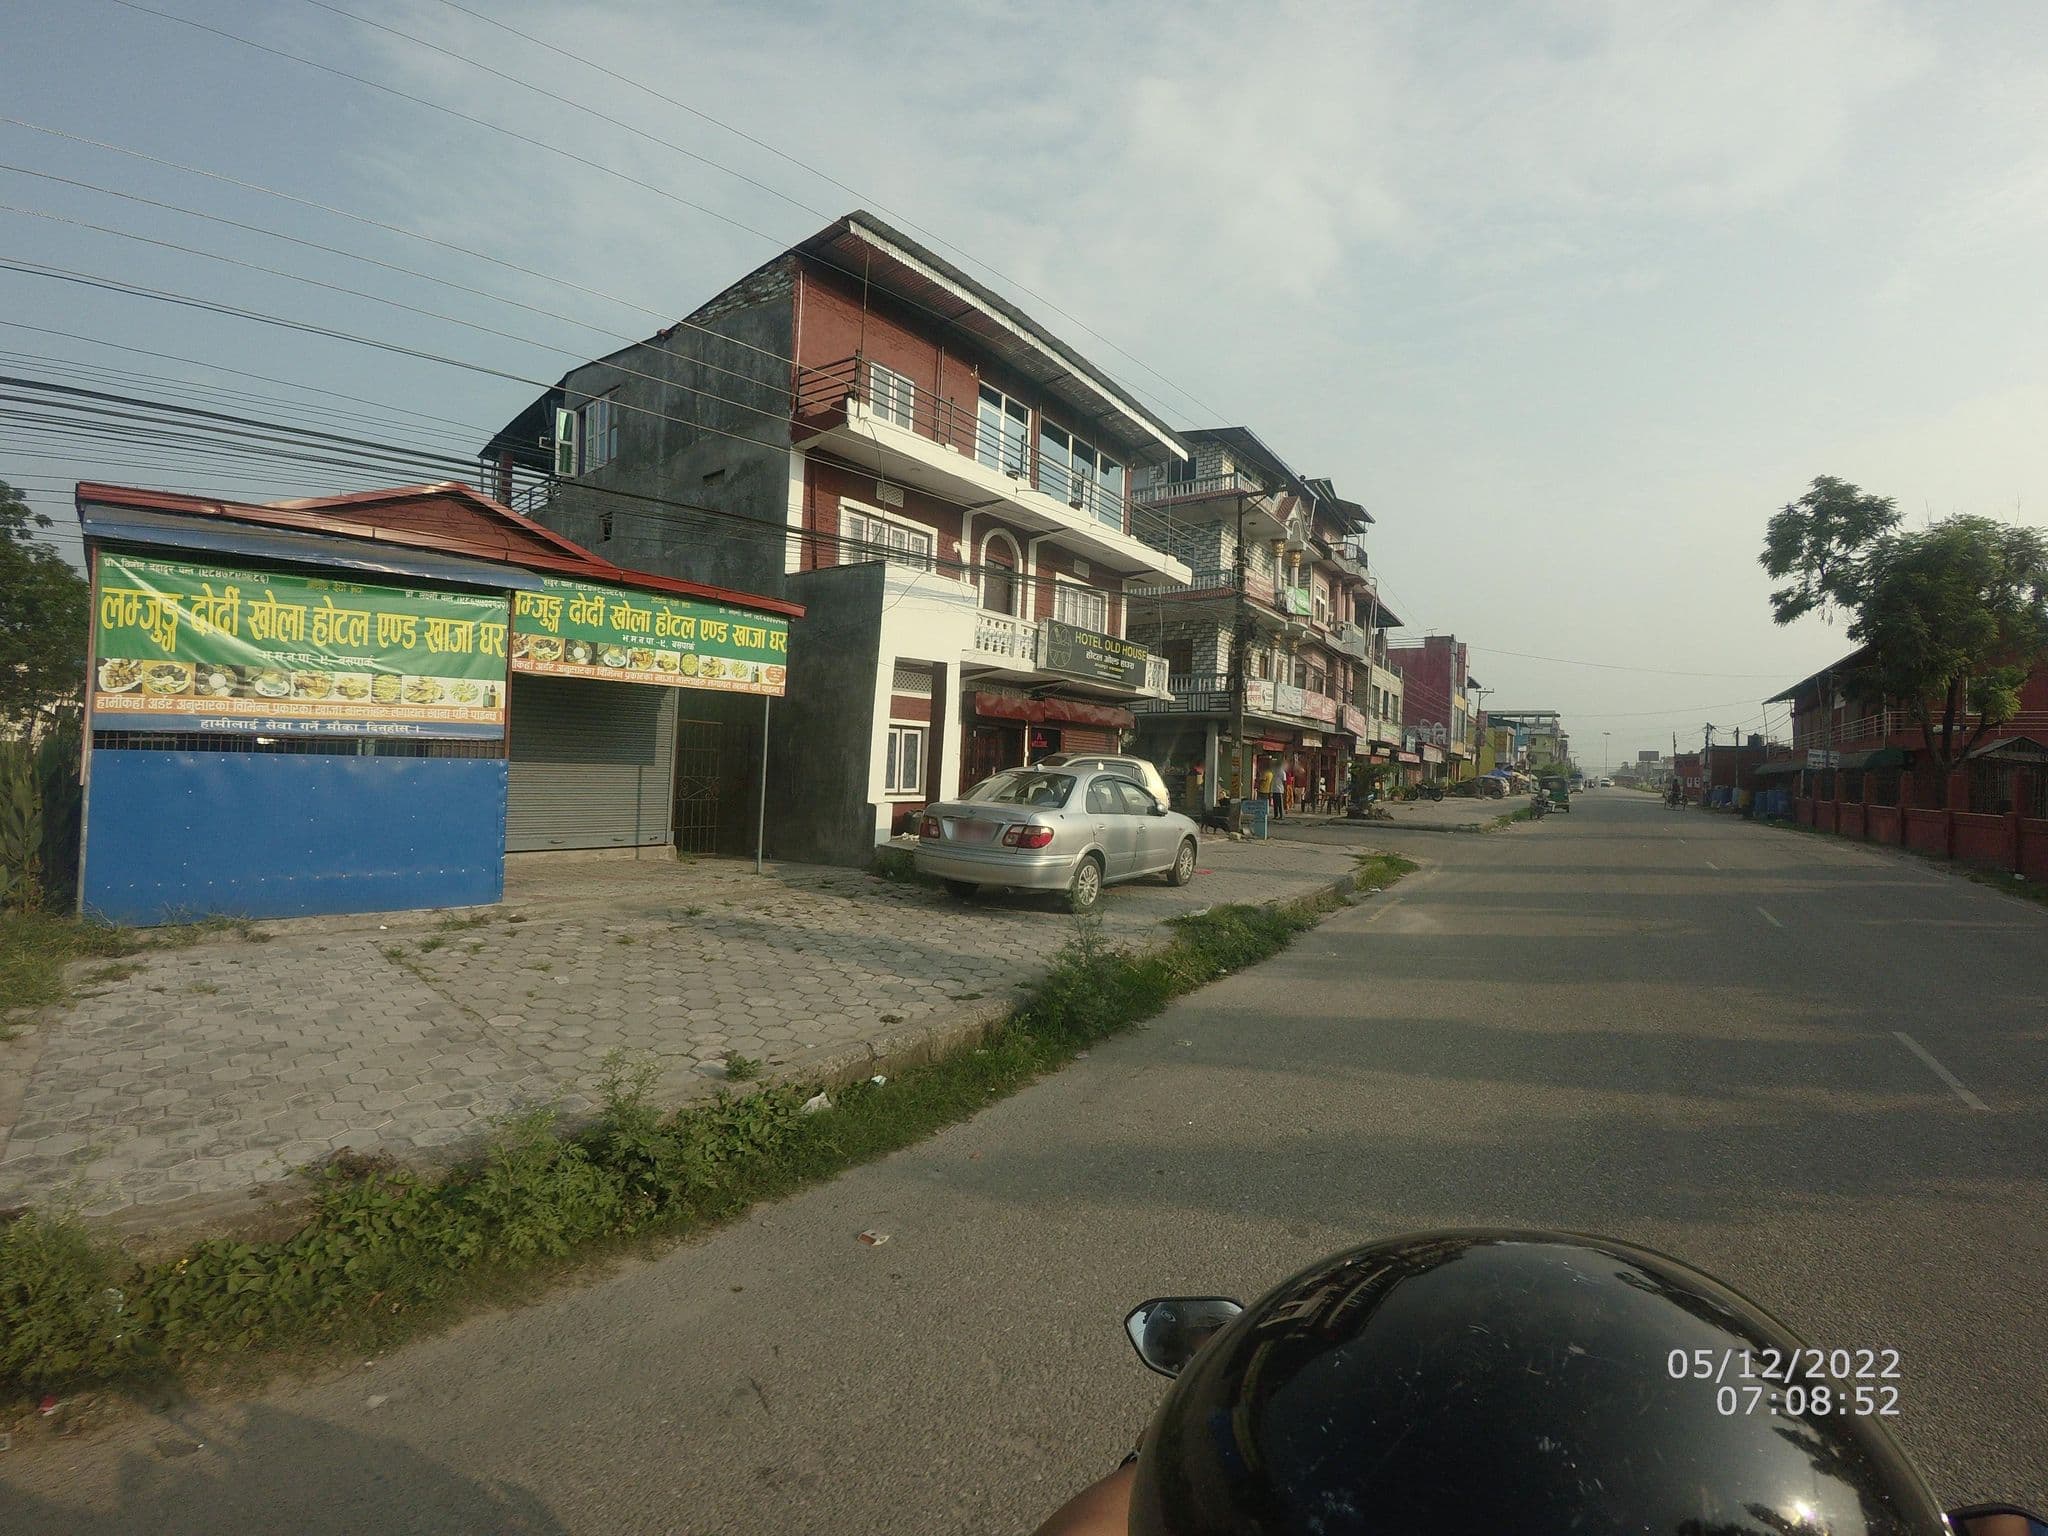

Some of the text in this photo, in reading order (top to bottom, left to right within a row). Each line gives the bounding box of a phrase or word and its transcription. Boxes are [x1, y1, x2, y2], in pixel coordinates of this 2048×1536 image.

[247, 590, 307, 642] खोला
[311, 596, 370, 647] होटल
[376, 612, 419, 649] एण्ड
[424, 616, 475, 653] खाजा
[479, 622, 507, 657] घर
[610, 602, 651, 632] खोला
[655, 608, 697, 637] होटल
[700, 619, 729, 643] एण्ड
[732, 624, 767, 649] खाजा
[769, 631, 788, 651] घर
[1075, 631, 1147, 663] HOTEL OLD HOUSE
[1086, 649, 1103, 662] होटल
[200, 718, 258, 730] हामीलाई
[265, 719, 293, 731] सेवा
[300, 720, 320, 731] गर्ने
[326, 720, 358, 732] मौका
